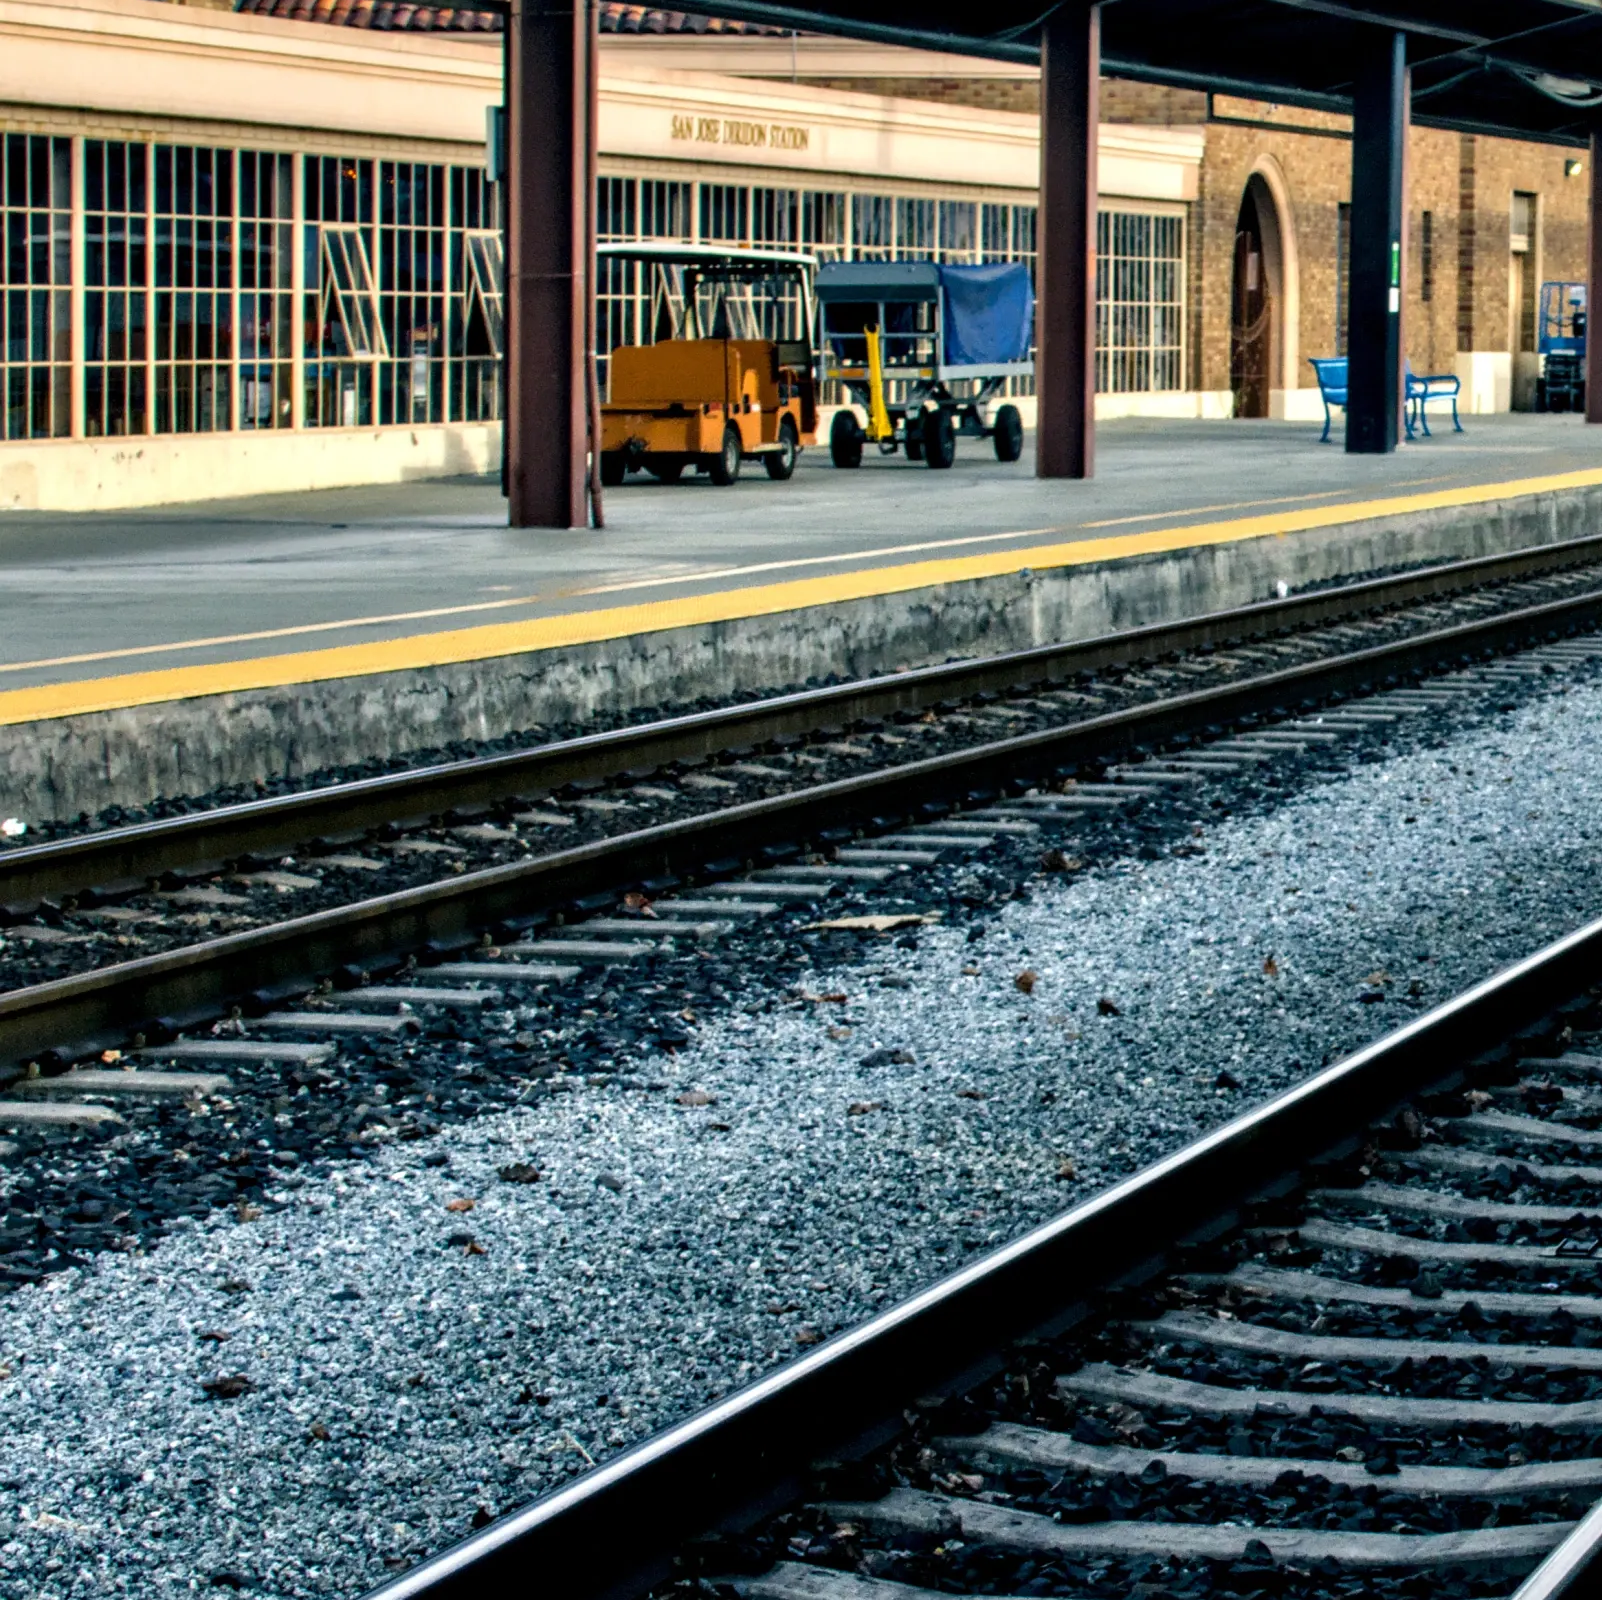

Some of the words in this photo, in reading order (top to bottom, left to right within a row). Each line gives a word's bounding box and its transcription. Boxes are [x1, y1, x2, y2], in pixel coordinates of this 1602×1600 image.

[672, 114, 694, 140] SAN
[696, 117, 720, 143] JOSE
[769, 124, 809, 151] STATION
